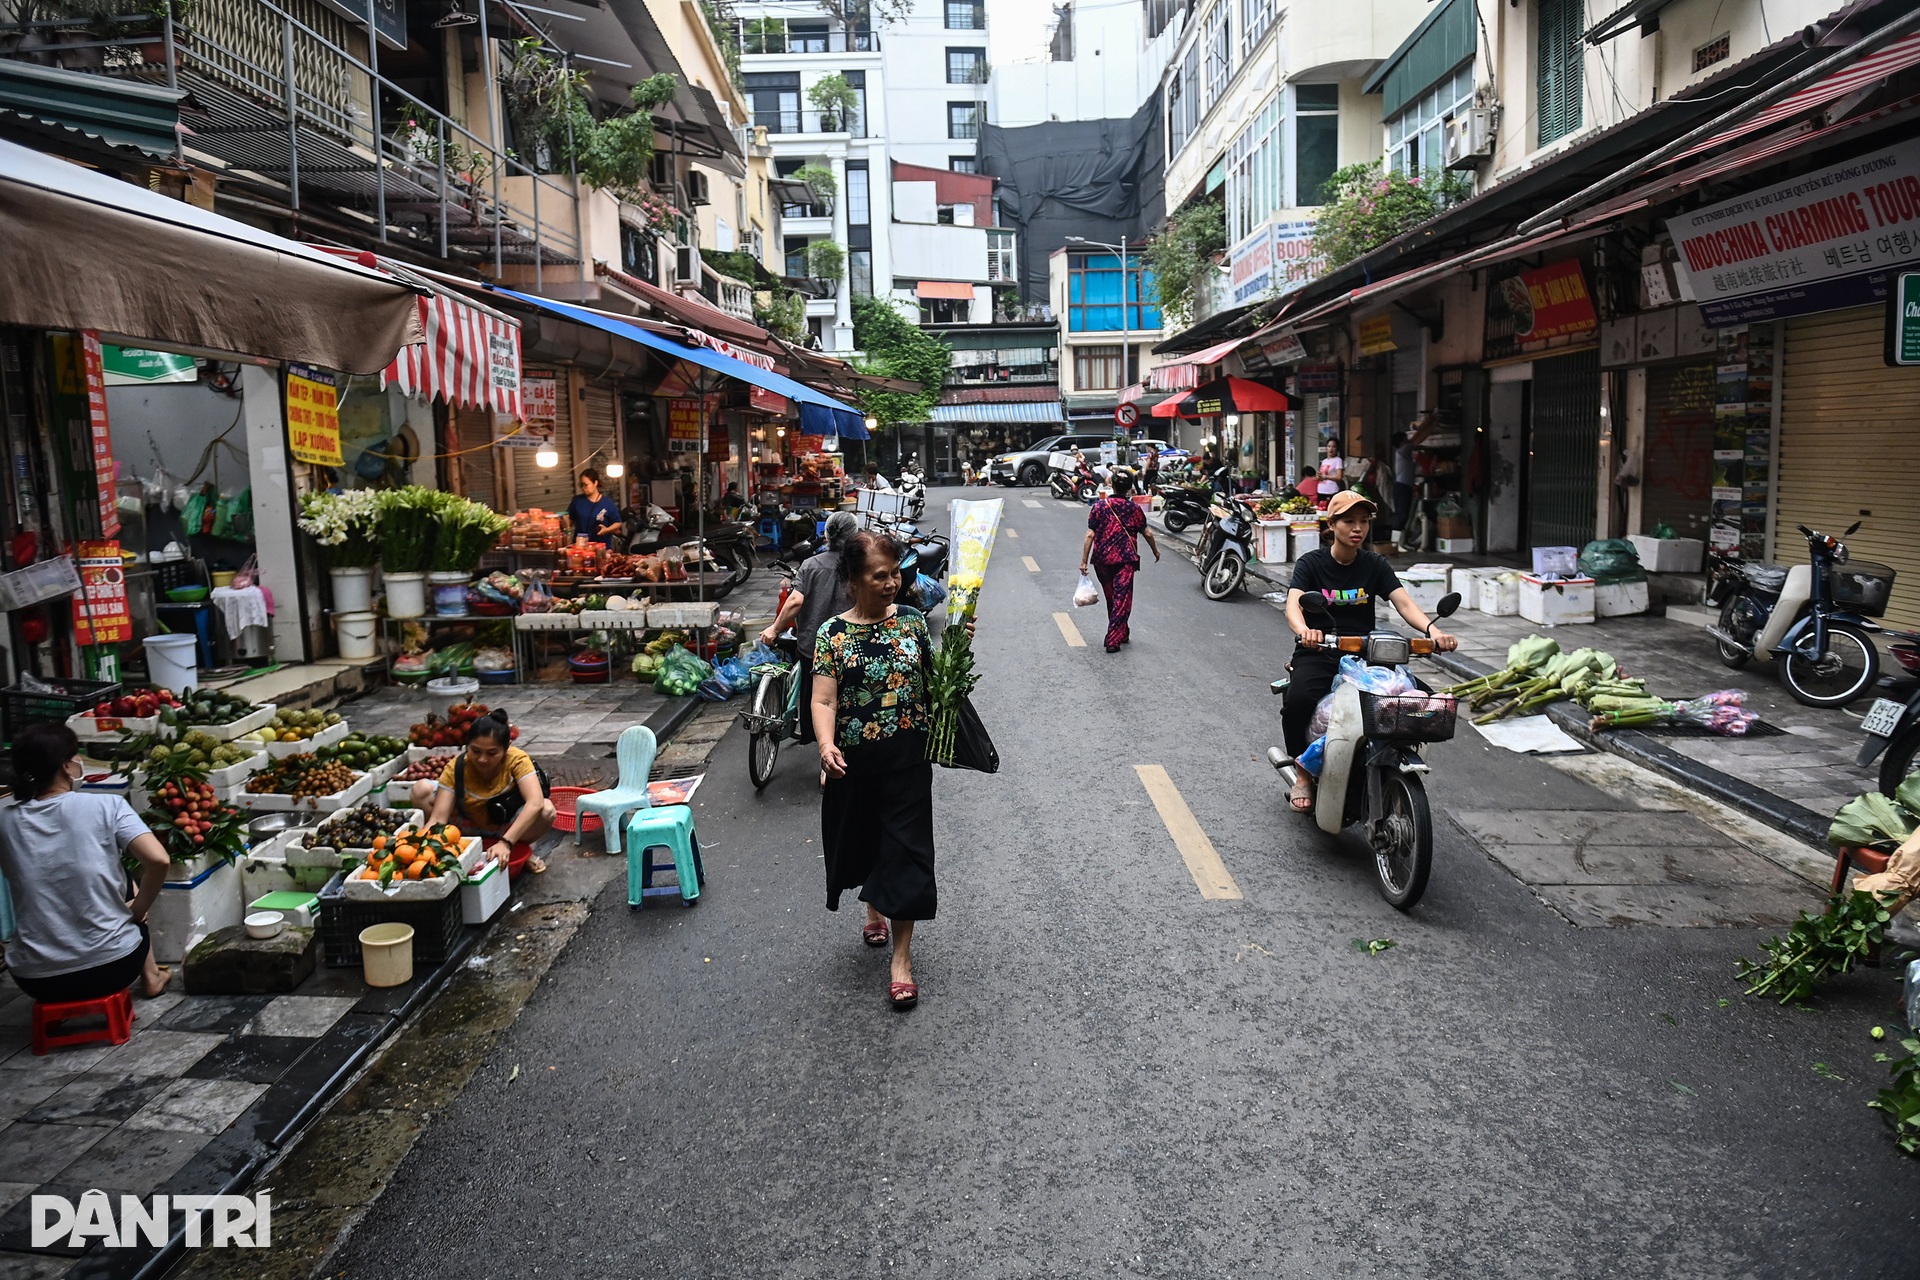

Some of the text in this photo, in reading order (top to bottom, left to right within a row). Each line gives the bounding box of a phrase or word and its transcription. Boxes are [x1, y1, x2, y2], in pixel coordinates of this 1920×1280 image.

[1705, 210, 1726, 222] TNHH
[1761, 195, 1776, 206] DU
[1682, 220, 1771, 273] INDOCHINA
[1765, 192, 1870, 252] CHARMING
[1824, 240, 1872, 268] 베트남
[1286, 259, 1325, 282] OFFIC
[1713, 257, 1807, 291] 越南地接旅行社
[1863, 715, 1894, 734] 053.22
